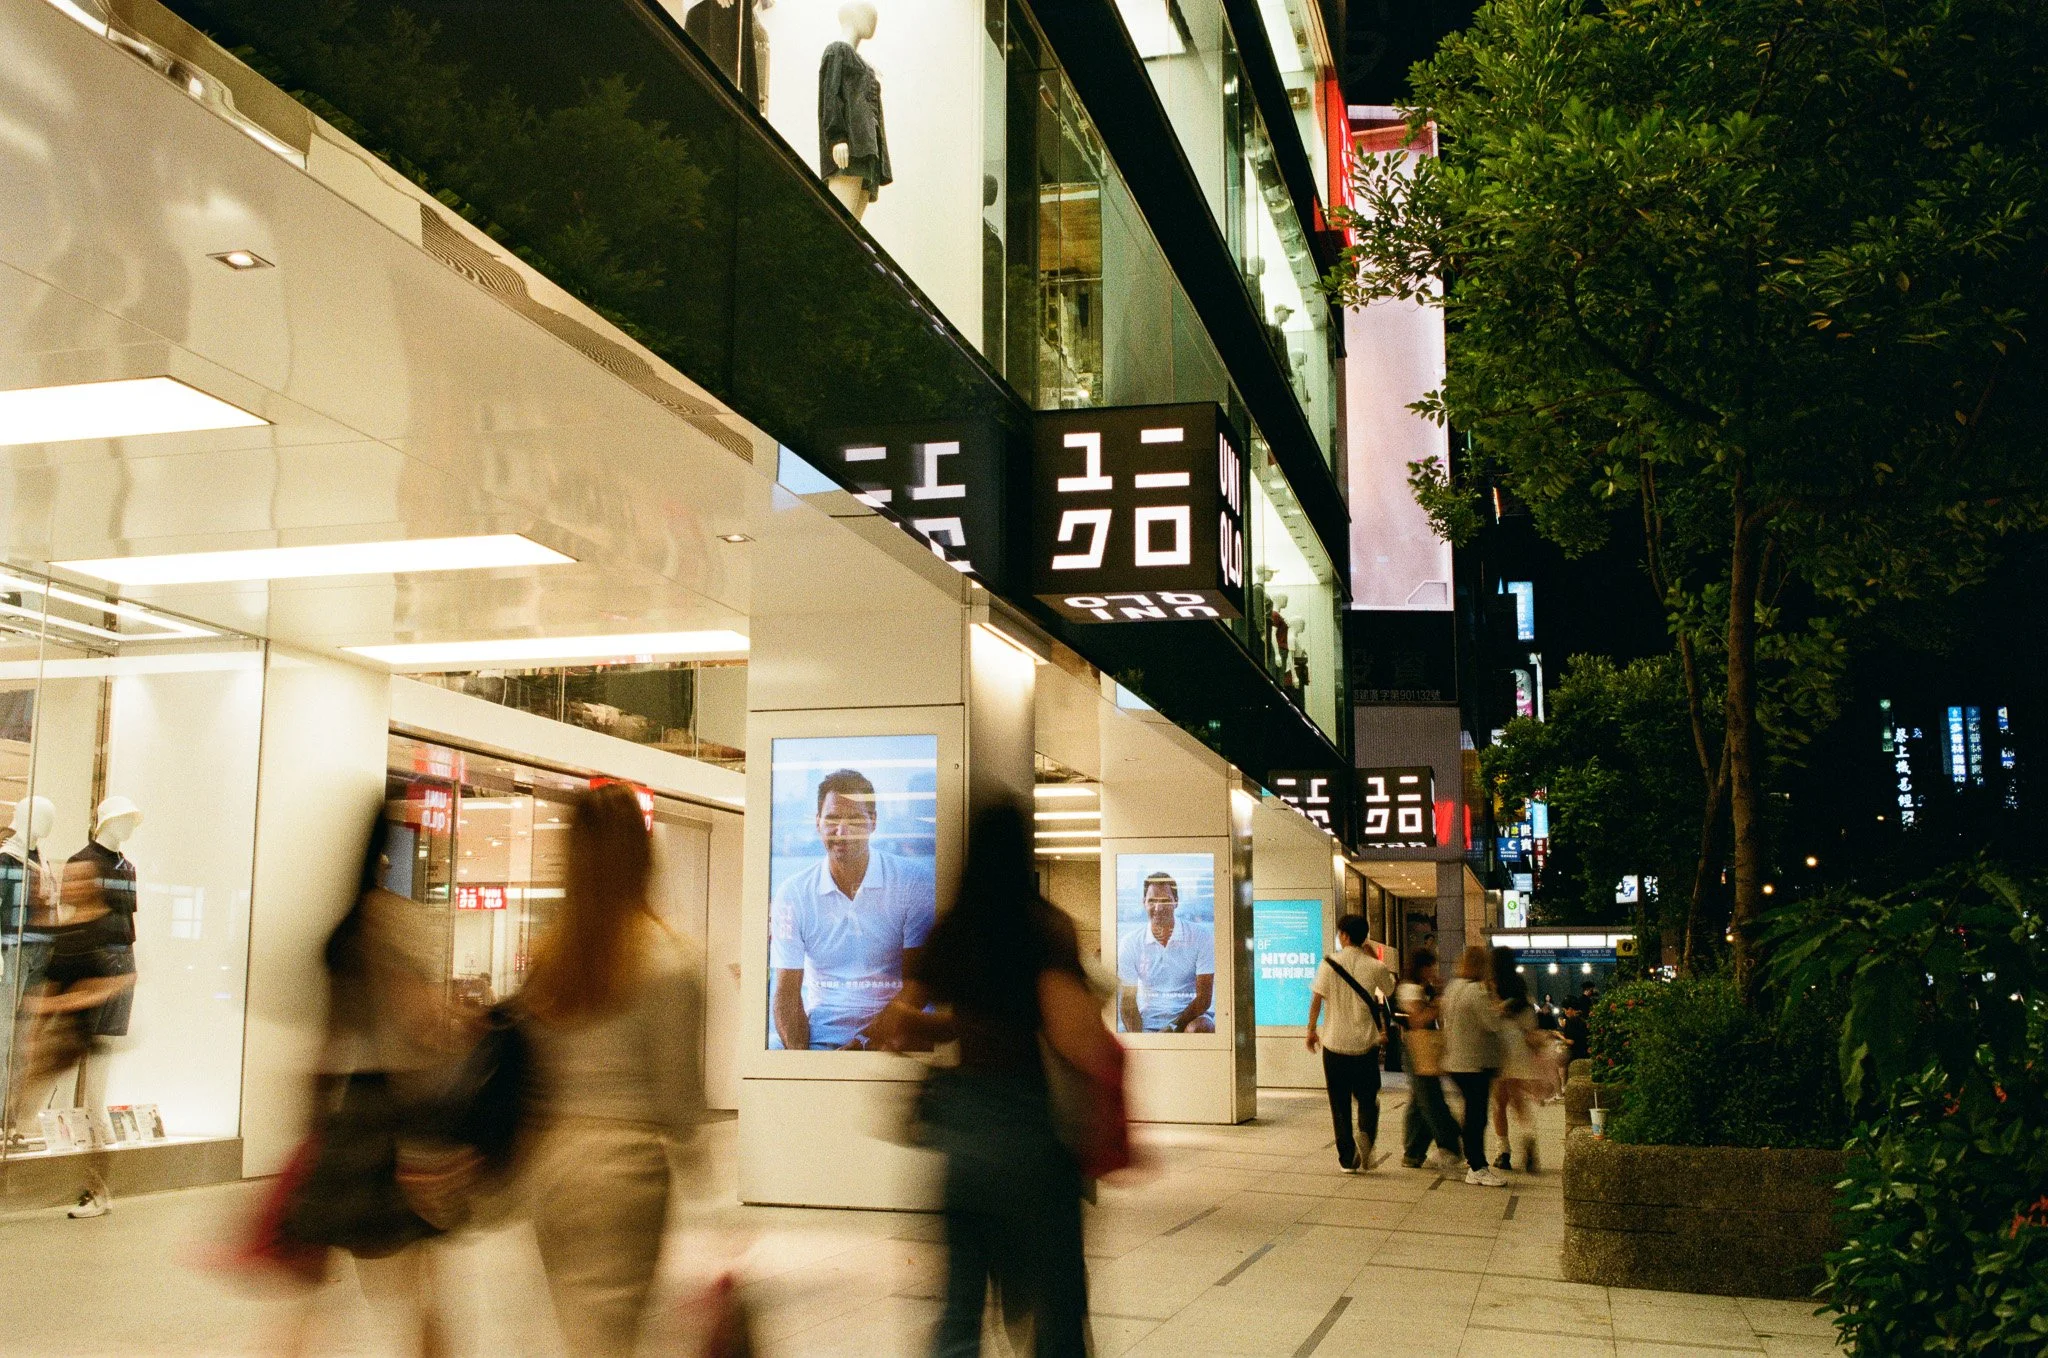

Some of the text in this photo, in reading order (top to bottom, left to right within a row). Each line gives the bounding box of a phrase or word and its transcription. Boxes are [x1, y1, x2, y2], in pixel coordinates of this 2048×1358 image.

[1057, 427, 1190, 492] ユニ
[1219, 432, 1240, 516] UNI
[1052, 505, 1190, 570] クロ
[1220, 511, 1242, 588] QLO
[1063, 591, 1206, 608] QLO
[1089, 605, 1220, 620] UNI
[1365, 776, 1421, 802] ユニ
[1364, 807, 1422, 834] クロ
[1257, 940, 1271, 950] 8F
[1261, 952, 1316, 965] NITORI
